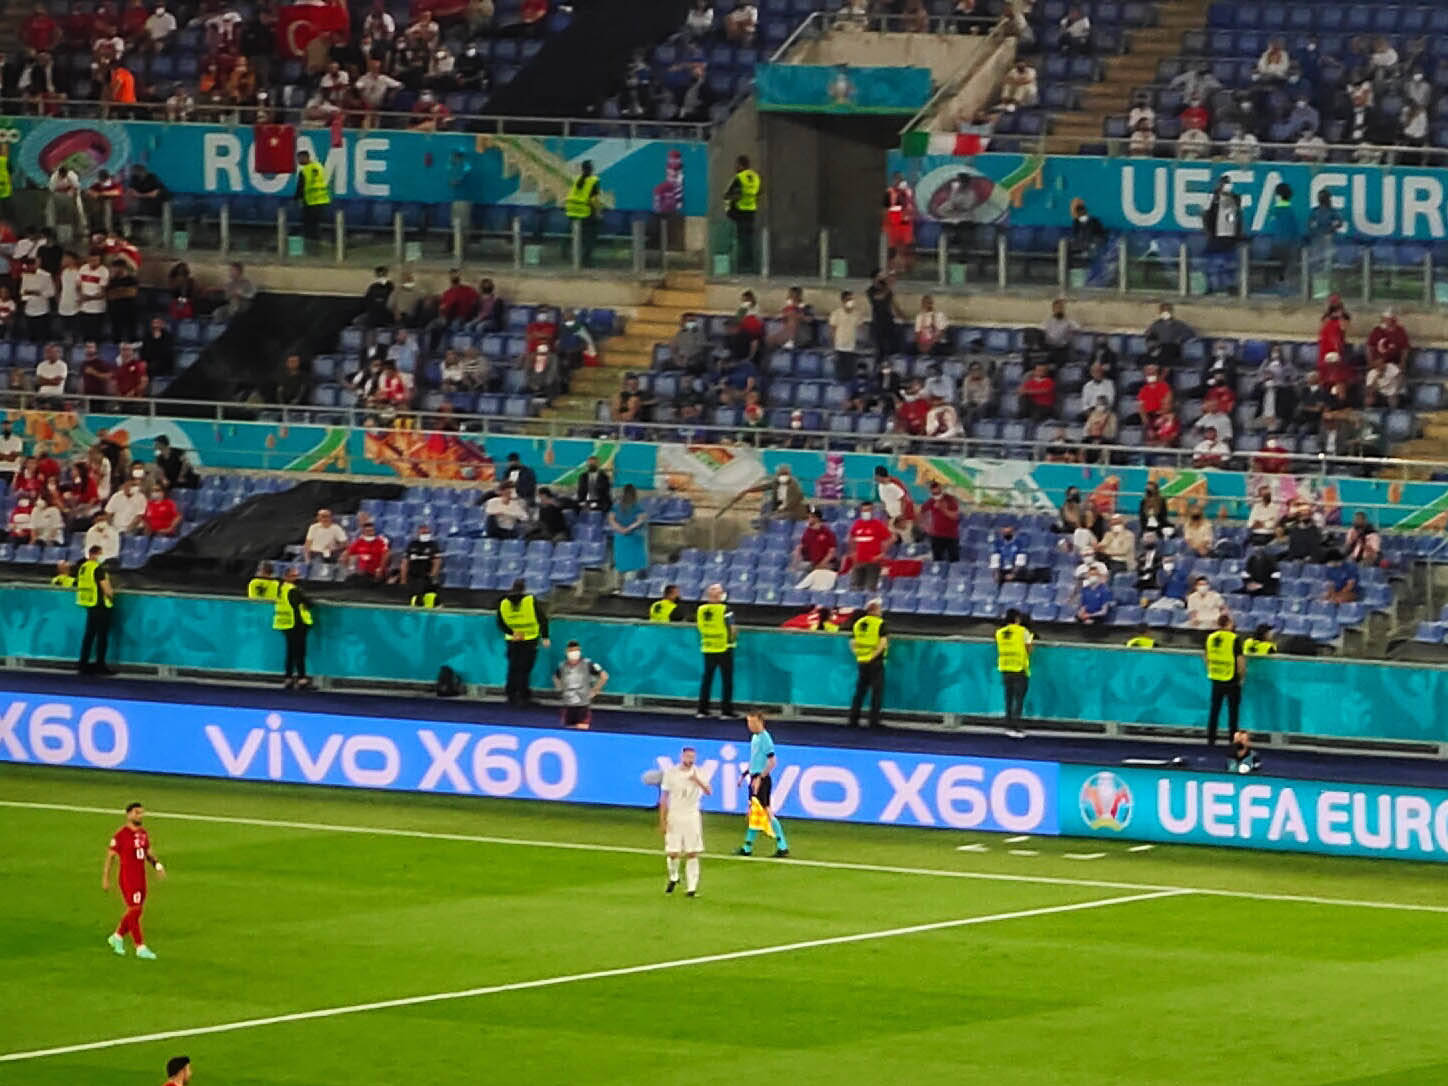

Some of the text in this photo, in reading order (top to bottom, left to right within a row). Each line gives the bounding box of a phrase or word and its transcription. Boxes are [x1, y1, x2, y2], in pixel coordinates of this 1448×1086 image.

[205, 713, 578, 800] vivo X60
[879, 760, 1045, 832] X60
[1158, 779, 1309, 842] UEFA
